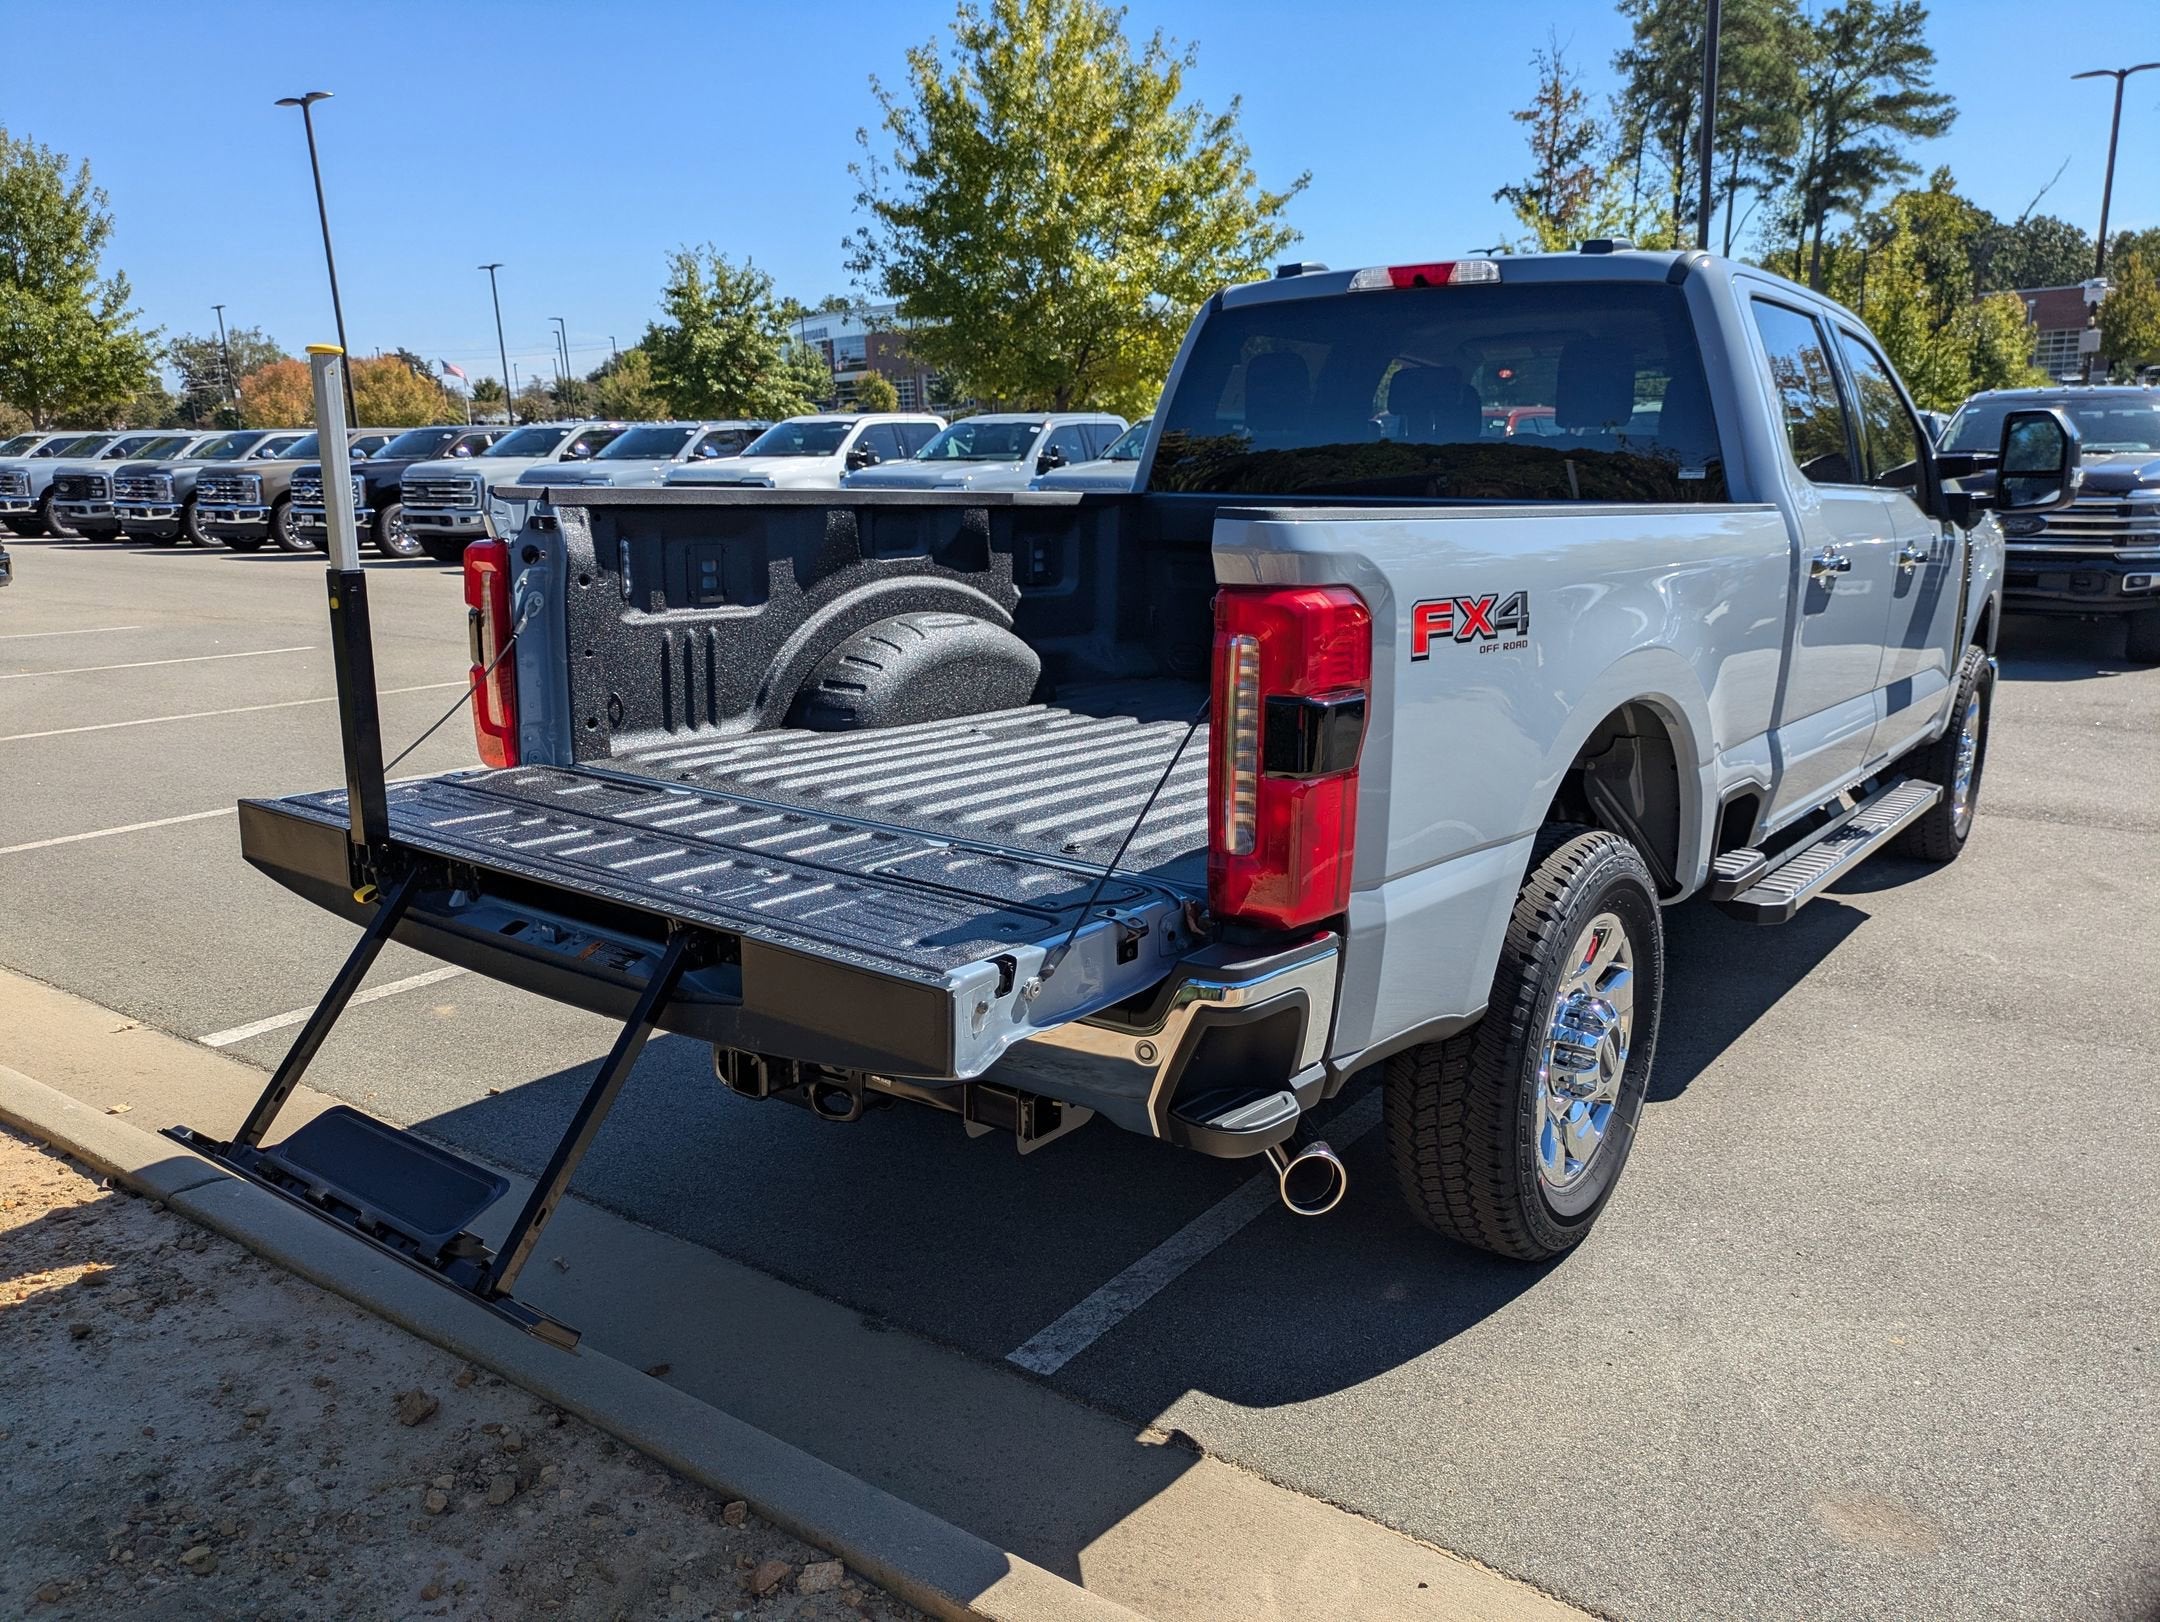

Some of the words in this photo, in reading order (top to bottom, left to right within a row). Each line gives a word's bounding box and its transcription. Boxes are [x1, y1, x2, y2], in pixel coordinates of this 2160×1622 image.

[1411, 591, 1529, 662] FX4
[1479, 644, 1500, 654] OFF
[1503, 639, 1528, 651] ROAD
